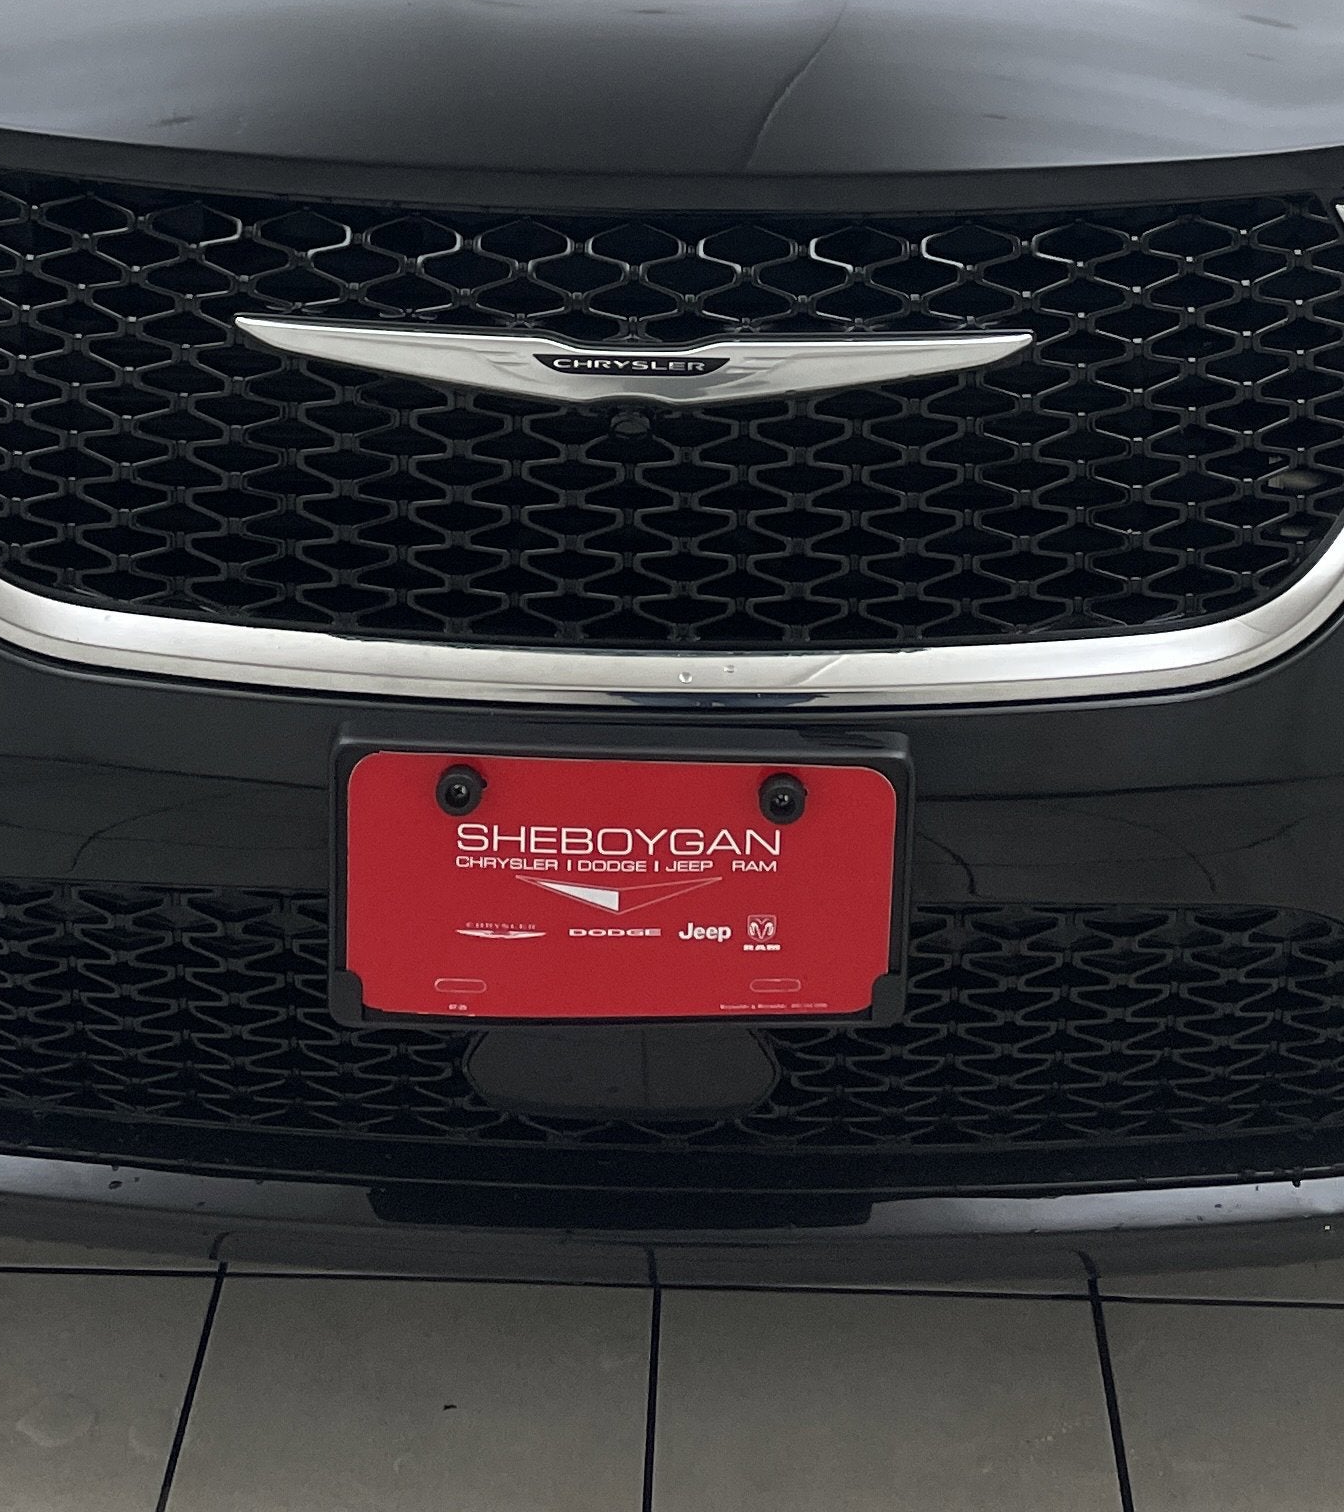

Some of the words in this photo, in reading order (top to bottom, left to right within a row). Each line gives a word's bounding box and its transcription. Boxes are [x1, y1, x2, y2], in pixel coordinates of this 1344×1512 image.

[553, 358, 706, 371] CHRYSLER
[457, 823, 782, 856] SHEBOYGAN
[456, 856, 558, 871] CHRYSLER
[577, 860, 647, 872] DODGE
[665, 860, 714, 873] JEEP
[732, 860, 777, 872] RAM
[568, 928, 661, 937] DODGE
[678, 922, 732, 943] Jeep
